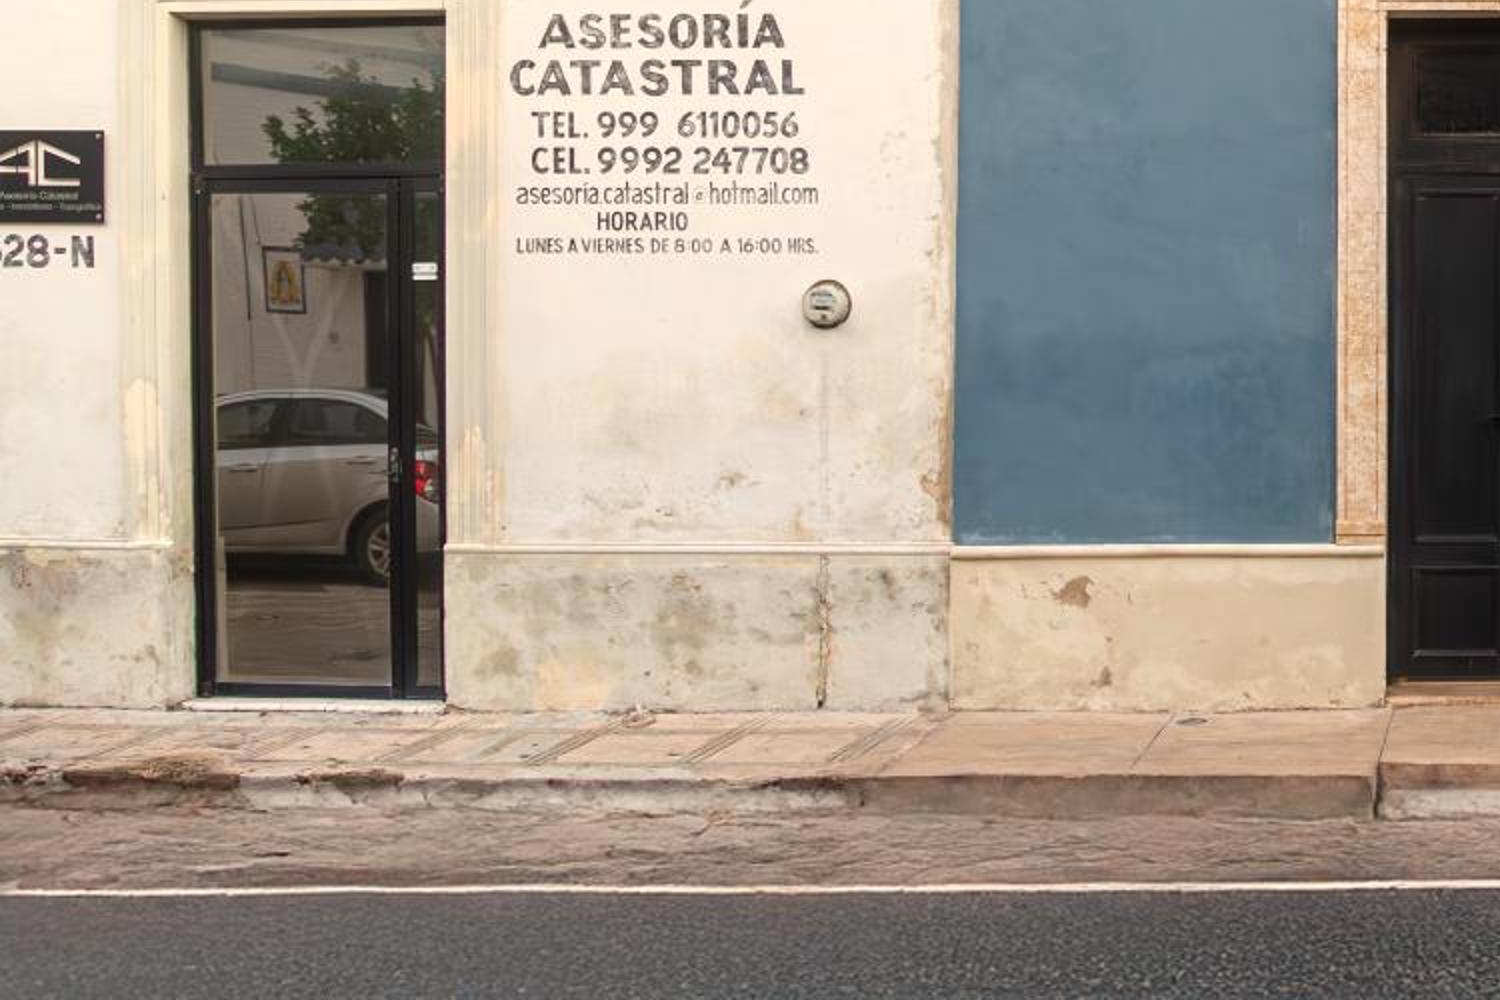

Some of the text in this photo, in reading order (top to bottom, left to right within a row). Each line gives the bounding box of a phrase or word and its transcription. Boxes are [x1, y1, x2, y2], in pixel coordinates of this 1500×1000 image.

[538, 0, 785, 50] ASESORÍA
[510, 58, 805, 97] CATASTRAL
[531, 111, 799, 139] TEL. 999 6110056
[531, 146, 810, 175] CEL. 9992 247708
[597, 211, 689, 232] HORARIO
[0, 234, 95, 269] 28-N
[516, 237, 563, 254] LUNES
[567, 237, 579, 254] A
[581, 237, 645, 254] VIERNES
[650, 237, 670, 254] DE
[674, 237, 713, 254] 8:00
[720, 237, 733, 254] A
[737, 237, 783, 254] 16:00
